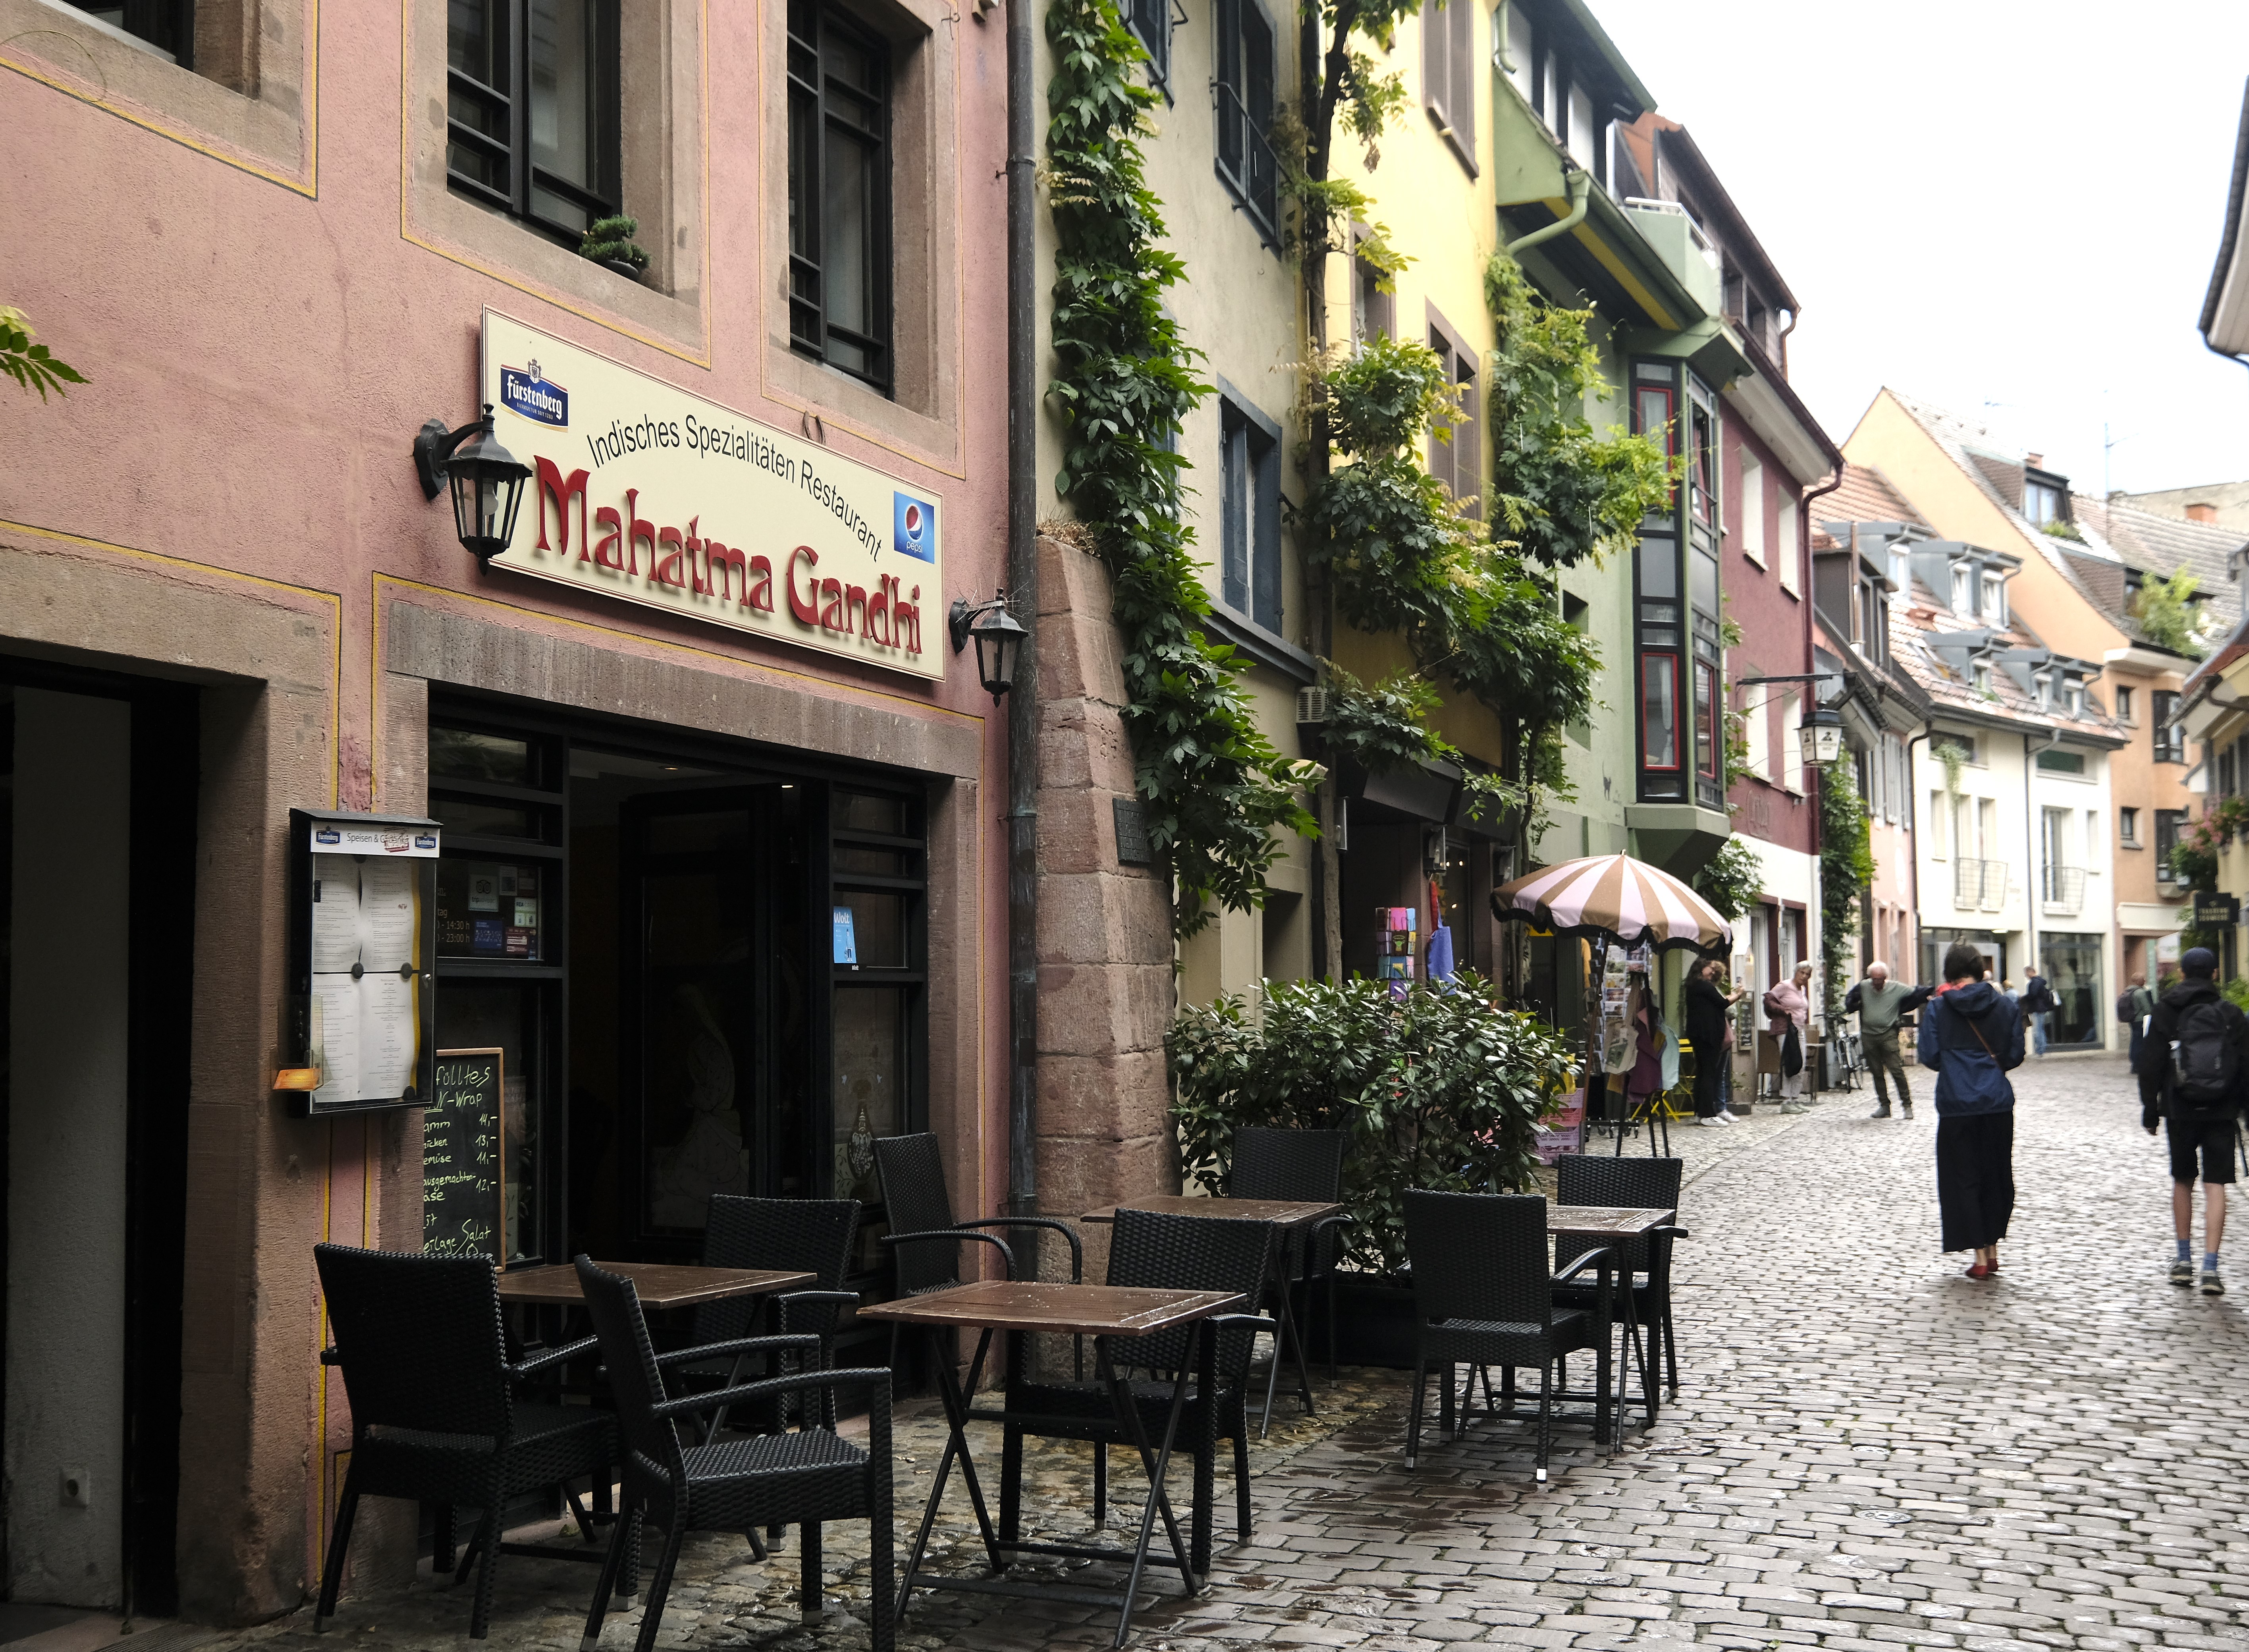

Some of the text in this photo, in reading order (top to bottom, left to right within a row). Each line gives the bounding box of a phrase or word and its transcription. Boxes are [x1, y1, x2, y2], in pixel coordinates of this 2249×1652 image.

[517, 402, 536, 414] BIERKULTUR
[587, 414, 882, 562] Indisches Spezialitäten Restaurant
[906, 541, 922, 553] pepsi
[534, 455, 923, 654] Mahatma Gandhi
[347, 833, 372, 843] Speisen
[374, 834, 378, 843] &
[834, 912, 850, 924] Wolt
[447, 921, 464, 930] 14:30
[466, 921, 470, 930] h
[446, 934, 464, 942] 23:00
[466, 934, 470, 943] h
[436, 1064, 490, 1087] fülltes
[426, 1090, 482, 1109] N-Wrap
[423, 1121, 450, 1133] amm
[423, 1138, 448, 1149] icken
[423, 1153, 452, 1165] emüse
[423, 1171, 476, 1191] ausgemachten-
[423, 1190, 446, 1202] äse
[423, 1218, 492, 1255] eilage Salat
